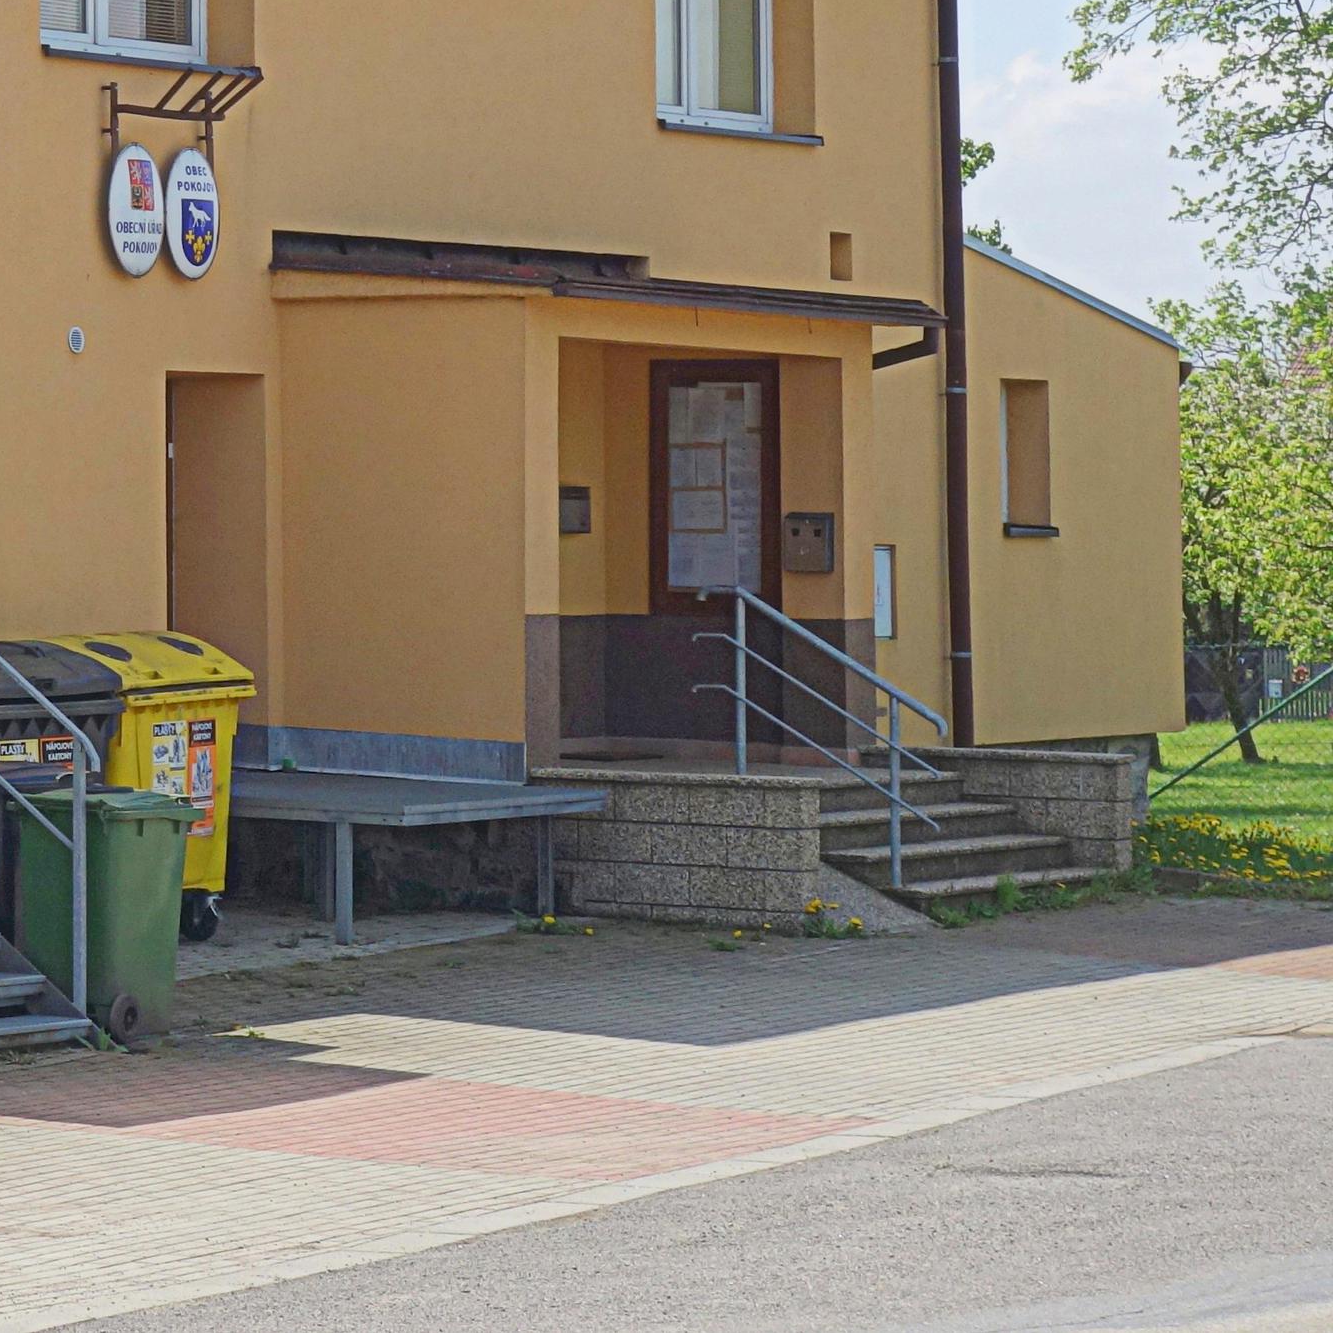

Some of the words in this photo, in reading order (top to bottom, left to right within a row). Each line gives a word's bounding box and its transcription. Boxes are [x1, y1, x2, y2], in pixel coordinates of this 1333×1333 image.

[185, 165, 207, 177] OBEC
[116, 219, 145, 234] OBECNÍ
[122, 241, 157, 254] POKOJOV
[0, 744, 25, 755] PLASTY
